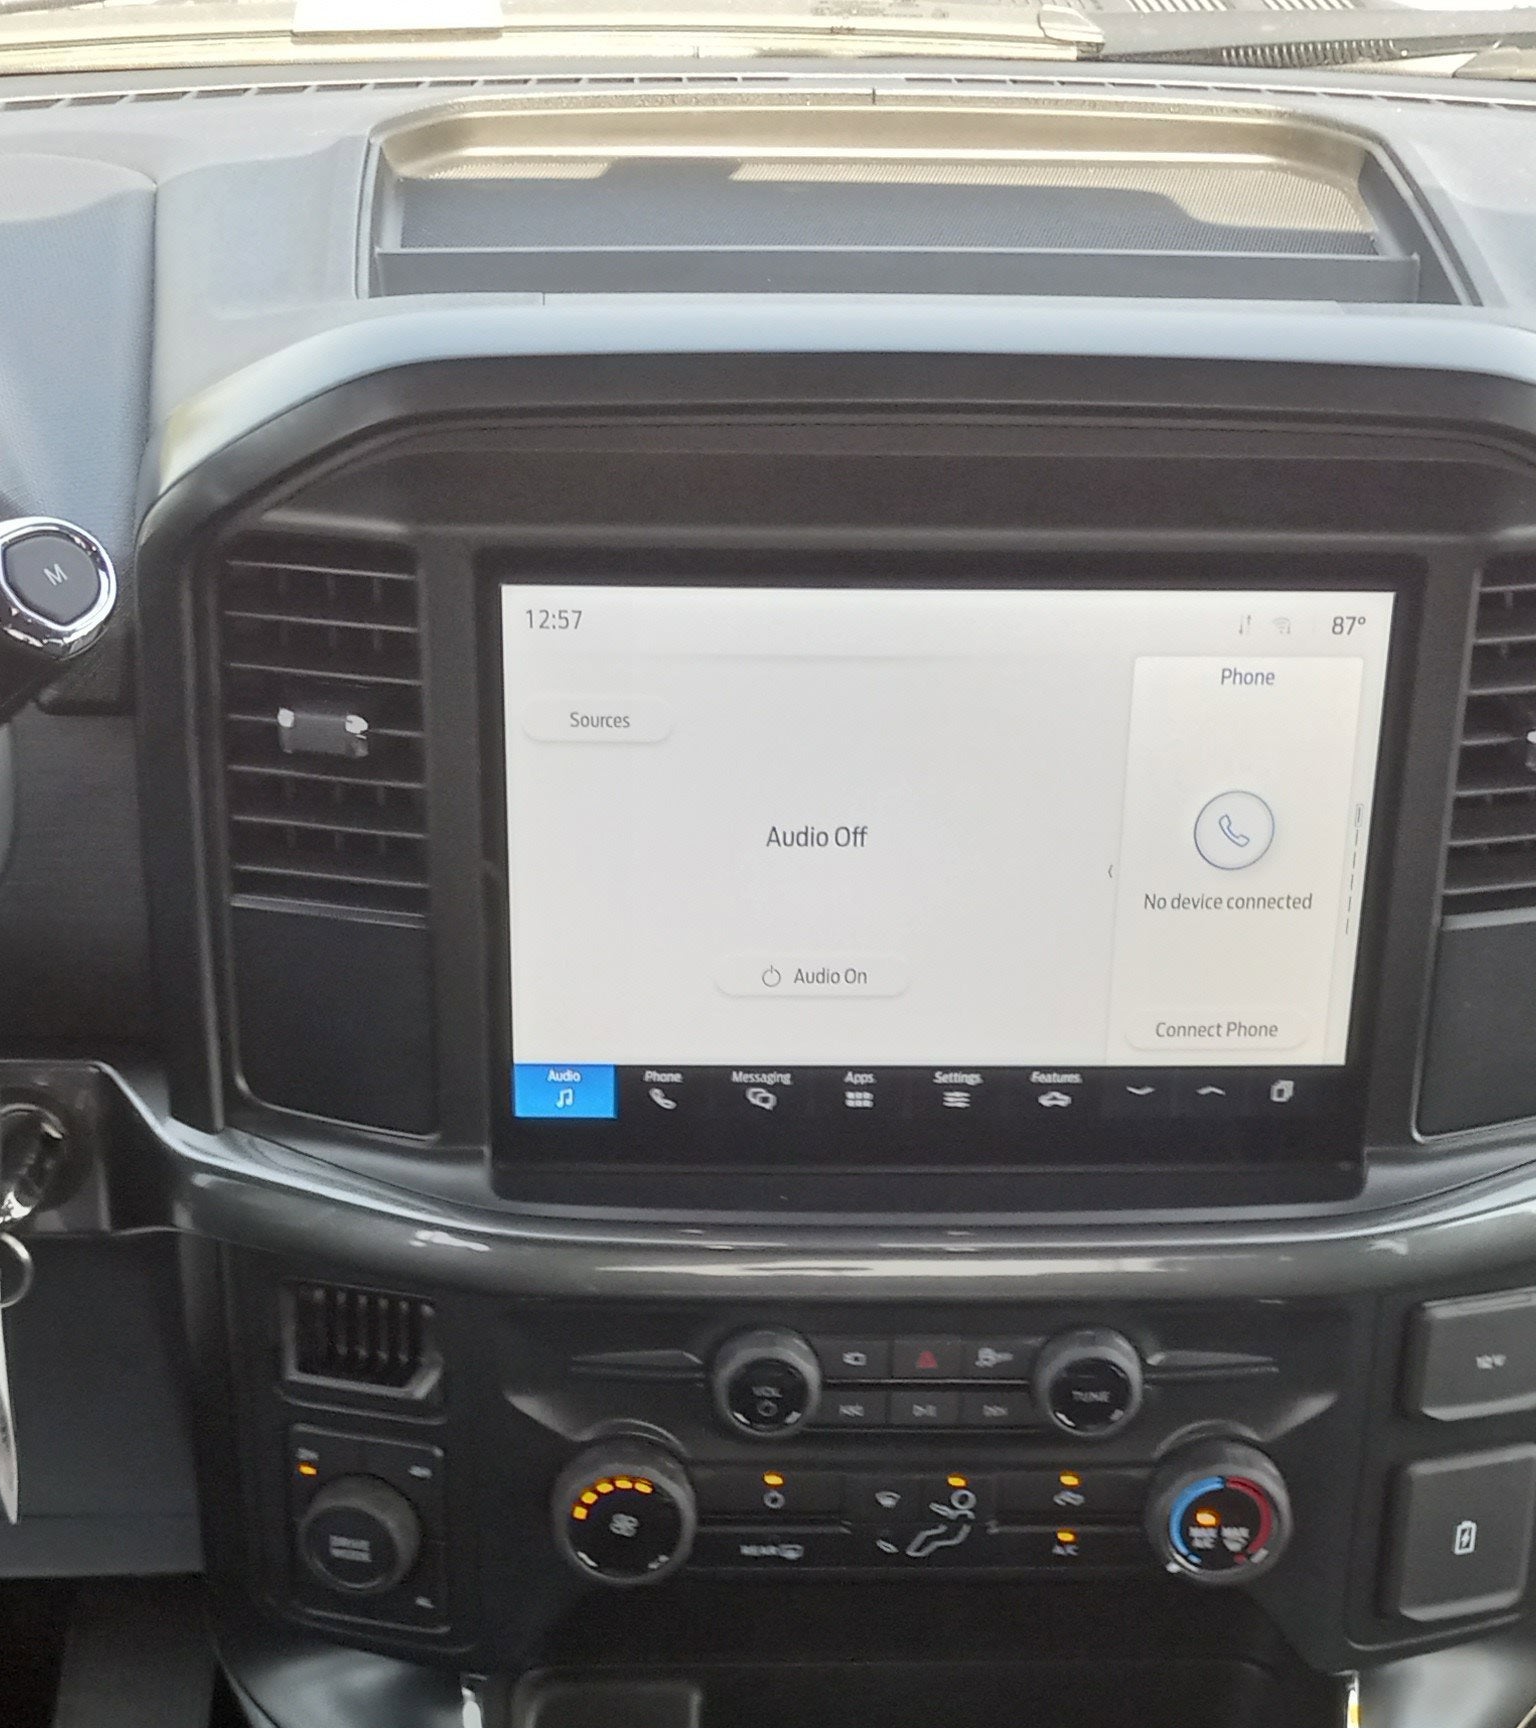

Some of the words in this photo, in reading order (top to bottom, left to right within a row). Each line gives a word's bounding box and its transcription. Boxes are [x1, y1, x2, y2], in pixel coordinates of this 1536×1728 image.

[43, 563, 68, 586] M
[526, 609, 582, 630] 12:57
[1221, 668, 1275, 686] Phone
[570, 712, 630, 728] Sources
[766, 825, 829, 847] Audio
[835, 826, 868, 847] Off
[1144, 893, 1167, 910] No
[1171, 893, 1223, 910] device
[1226, 892, 1313, 910] connected
[793, 967, 840, 984] Audio
[844, 968, 867, 984] On
[1155, 1022, 1222, 1038] Connect
[1226, 1021, 1278, 1038] Phone
[547, 1069, 581, 1082] Audio
[643, 1070, 683, 1083] Phone
[732, 1070, 792, 1085] Messaging
[844, 1071, 876, 1085] Apps
[933, 1071, 983, 1085] Settings
[1030, 1071, 1082, 1083] Features
